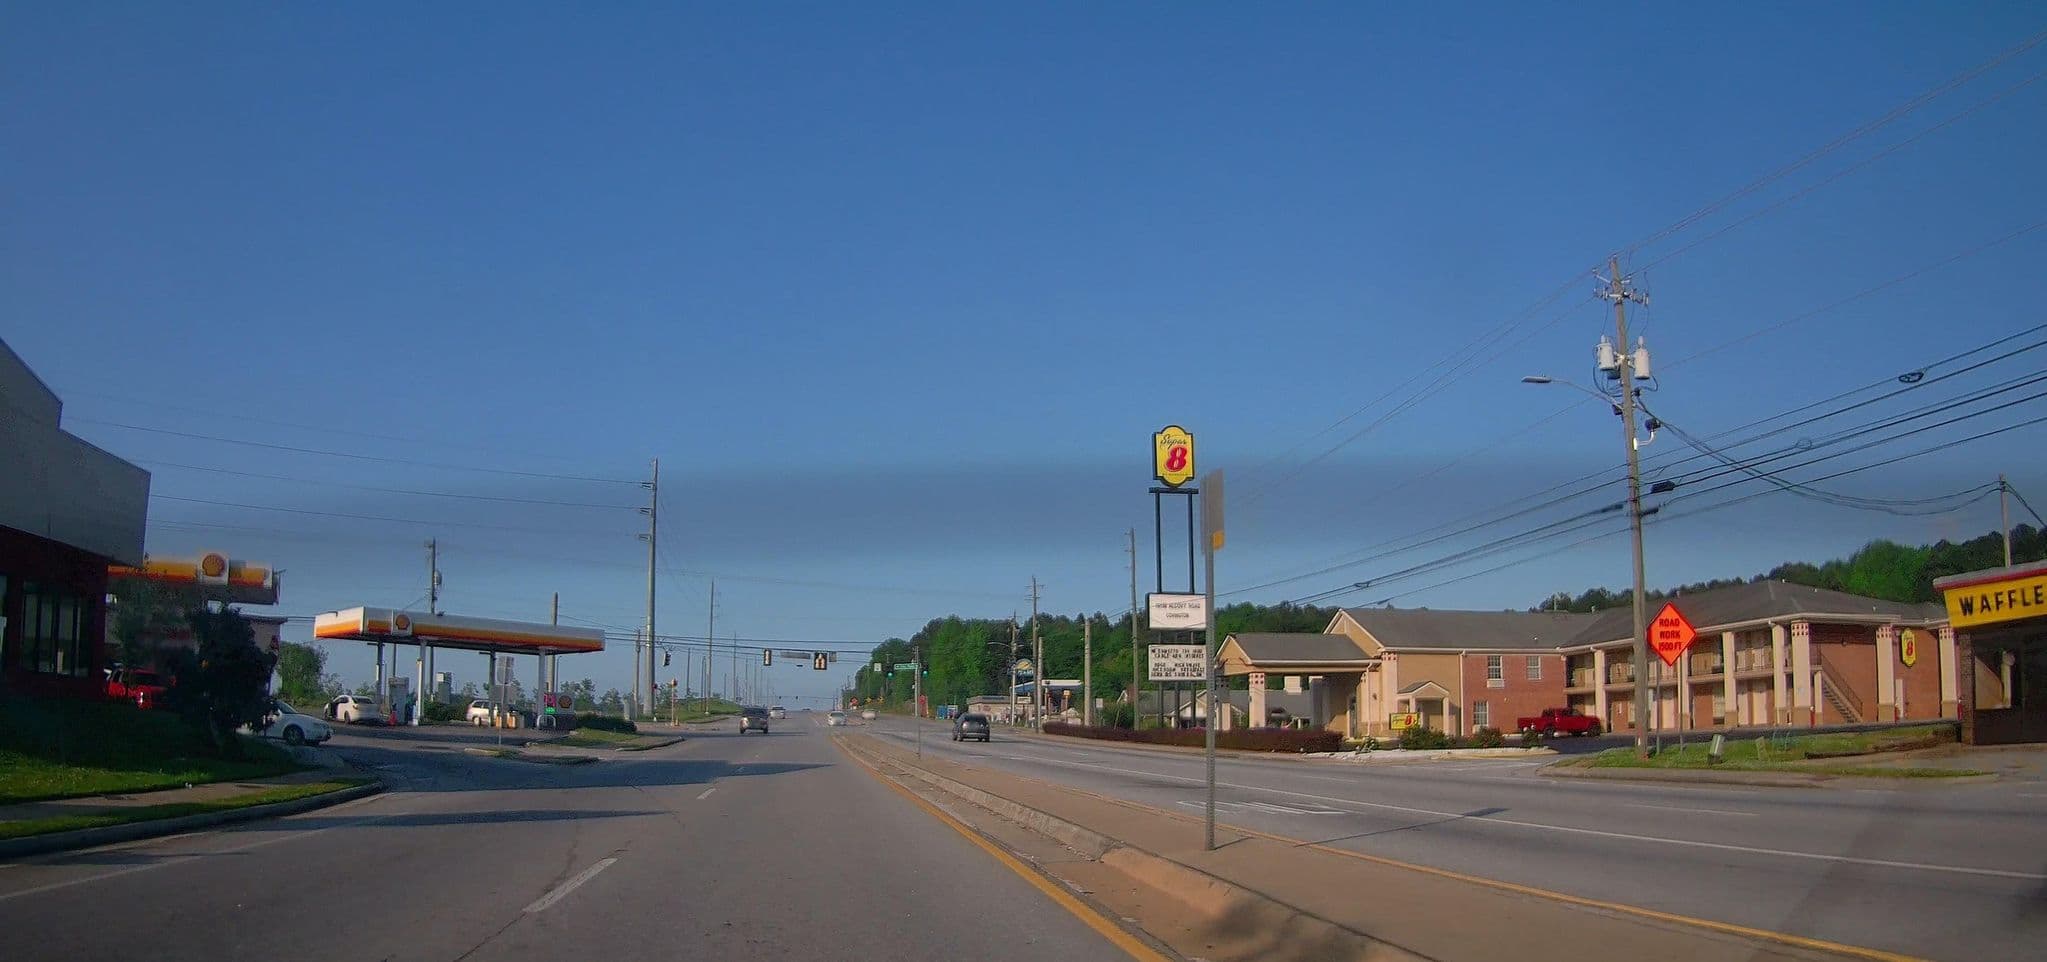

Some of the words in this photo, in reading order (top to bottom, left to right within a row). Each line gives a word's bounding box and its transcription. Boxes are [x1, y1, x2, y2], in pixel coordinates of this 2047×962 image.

[1160, 434, 1187, 449] Super
[1166, 446, 1187, 472] 8
[1959, 585, 2044, 616] WAFFLE
[1659, 618, 1680, 627] ROAD
[1659, 631, 1680, 639] WORK
[1658, 642, 1673, 651] 1500
[1675, 641, 1681, 650] FT
[1906, 640, 1913, 656] 8
[1405, 715, 1412, 725] 8
